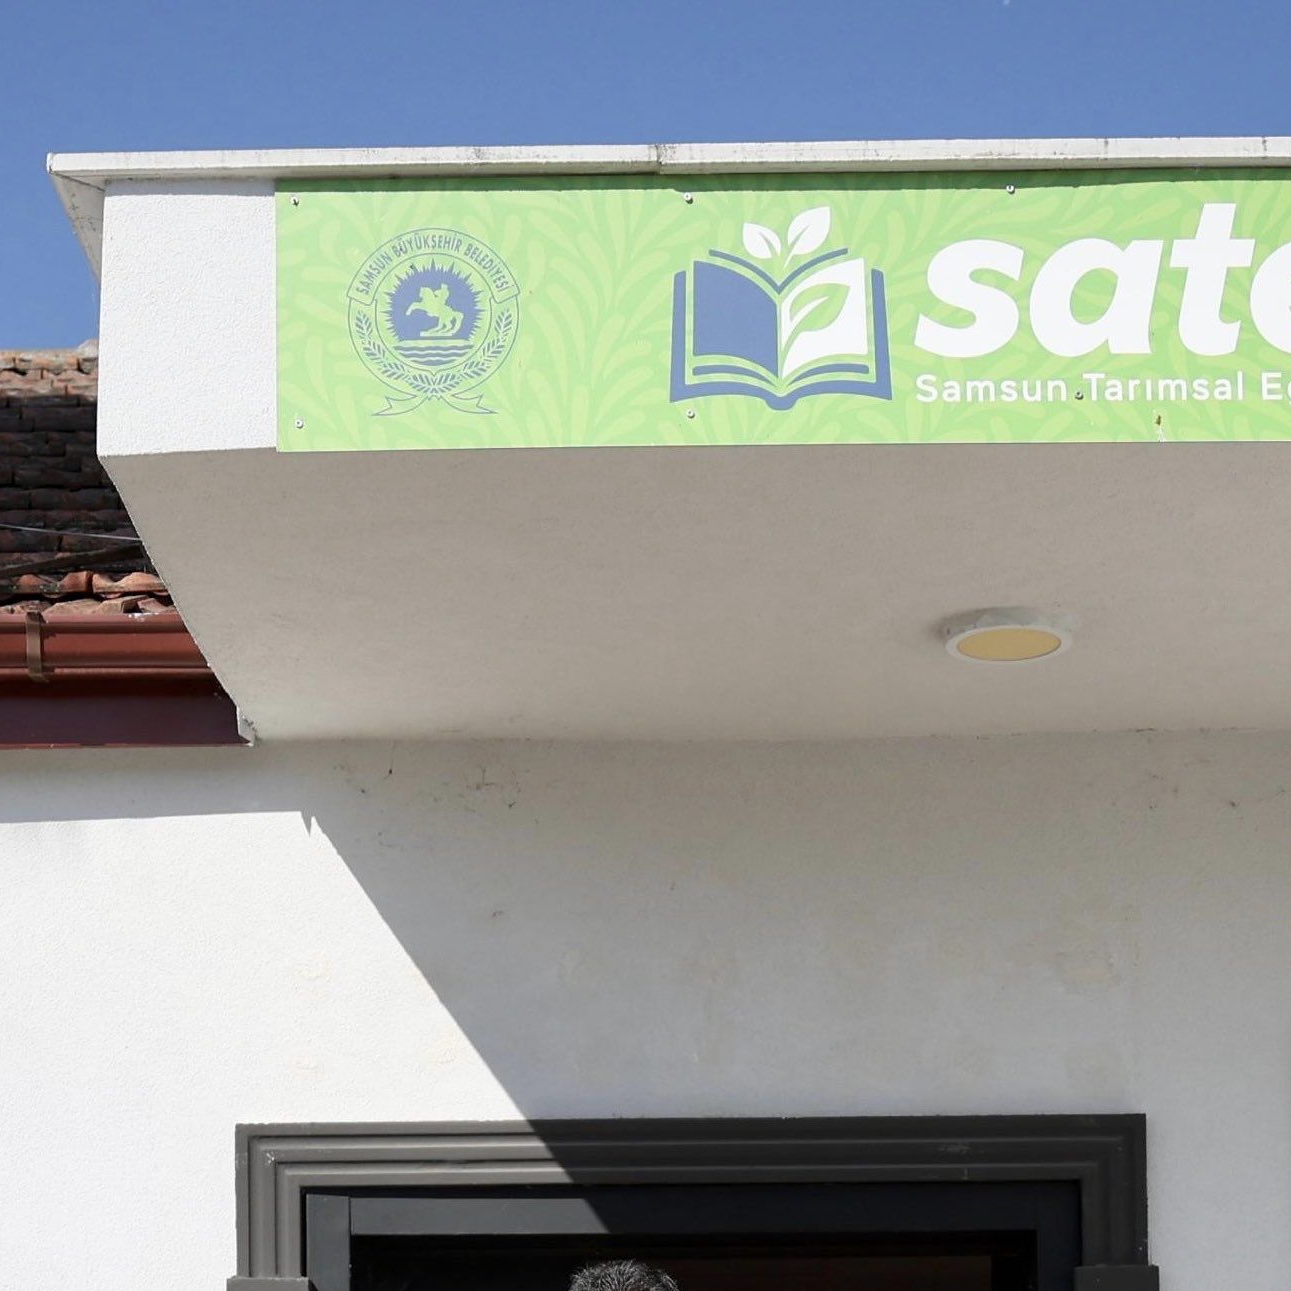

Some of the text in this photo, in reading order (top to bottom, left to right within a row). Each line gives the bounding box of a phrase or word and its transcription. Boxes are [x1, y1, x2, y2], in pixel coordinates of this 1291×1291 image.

[356, 233, 513, 294] SAMSUN BÜYÜKŞEHİR BELEDİYESİ
[915, 373, 1067, 403] Samsun
[1082, 370, 1244, 402] Tarımsal
